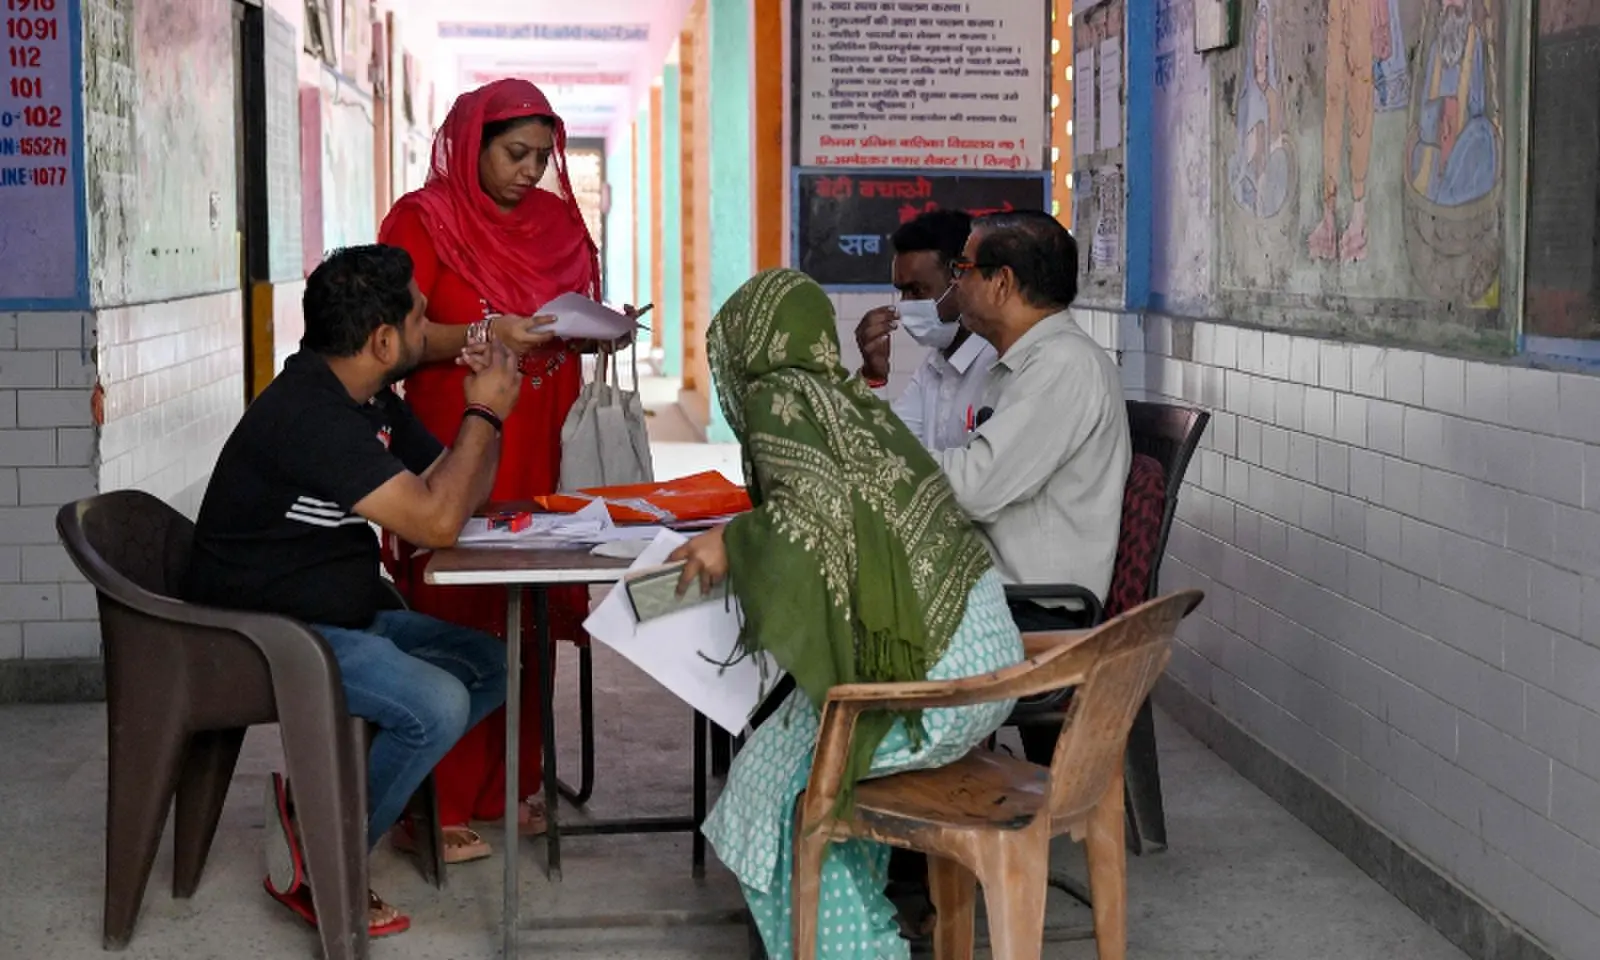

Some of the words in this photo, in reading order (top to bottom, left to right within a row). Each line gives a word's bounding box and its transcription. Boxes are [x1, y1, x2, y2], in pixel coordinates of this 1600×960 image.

[7, 17, 57, 40] 1091
[9, 45, 41, 68] 112
[10, 76, 42, 98] 101
[838, 233, 881, 257] सब
